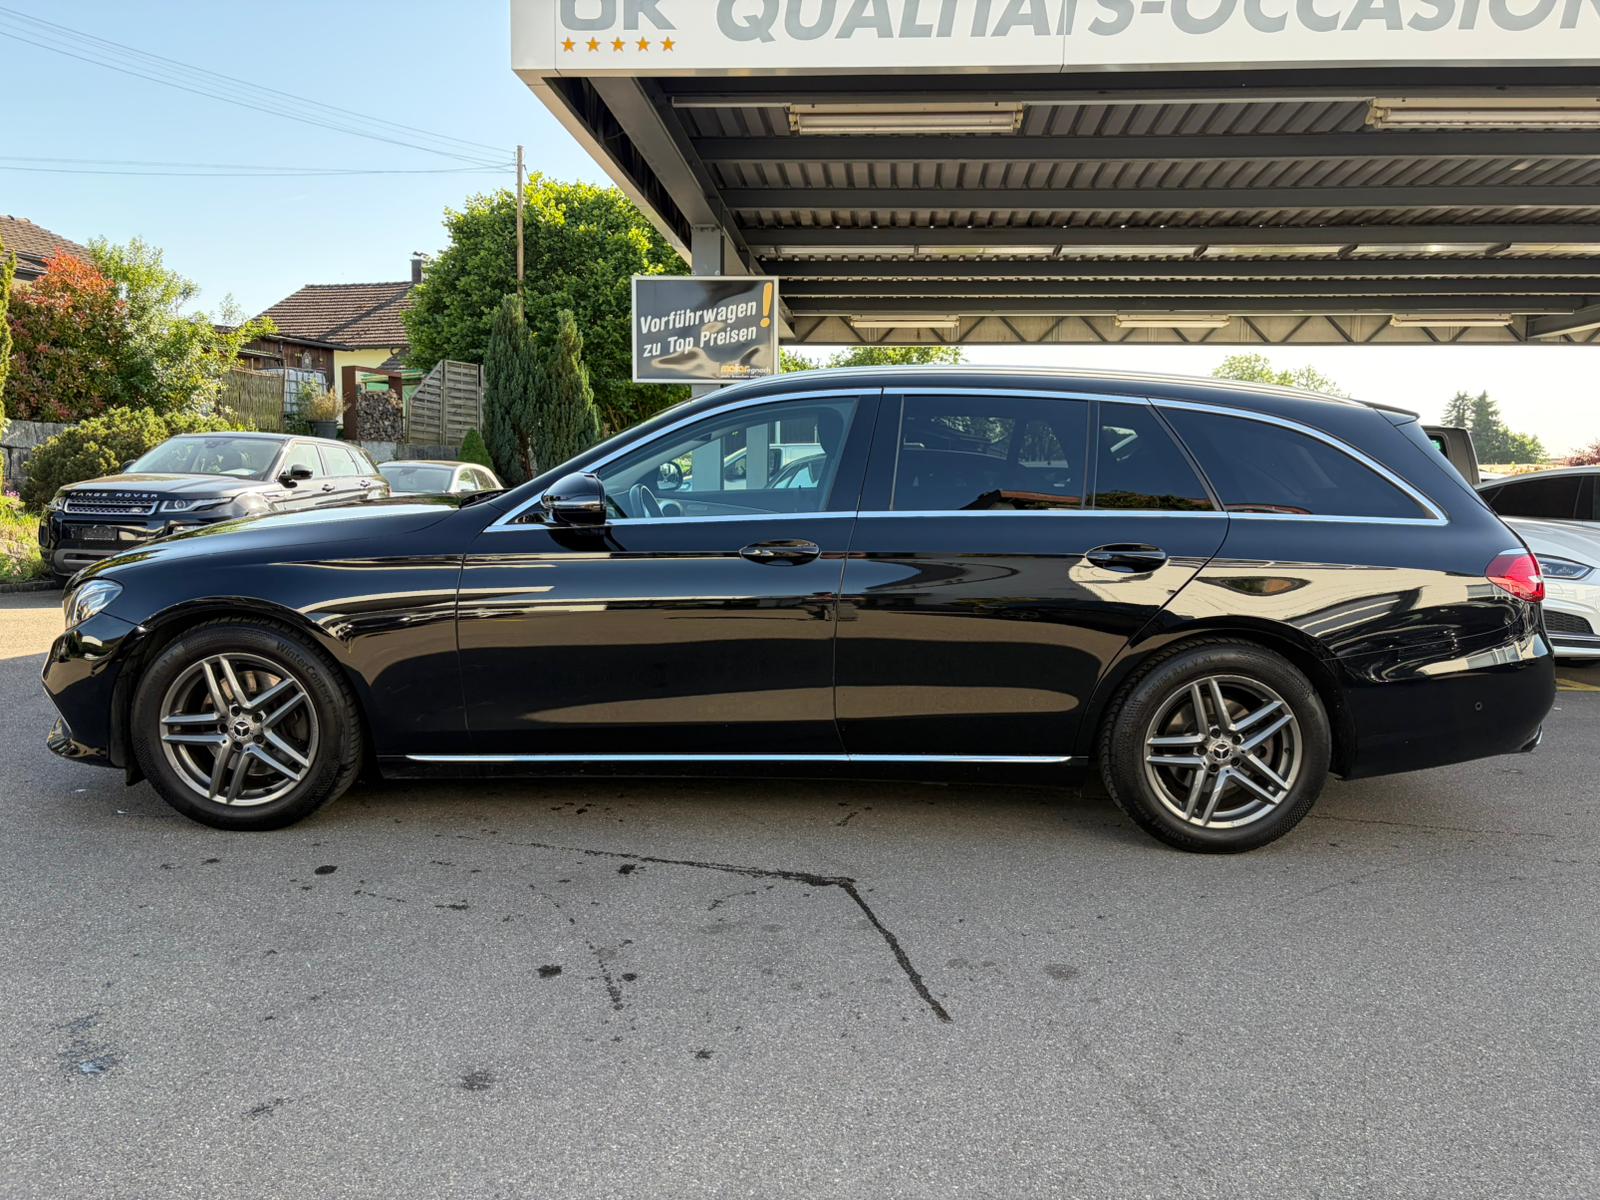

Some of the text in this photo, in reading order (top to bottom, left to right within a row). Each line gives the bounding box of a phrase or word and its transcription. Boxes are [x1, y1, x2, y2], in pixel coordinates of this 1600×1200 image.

[560, 0, 677, 31] OK
[640, 301, 757, 334] Vorführwagen
[642, 326, 757, 358] zu Top Preisen
